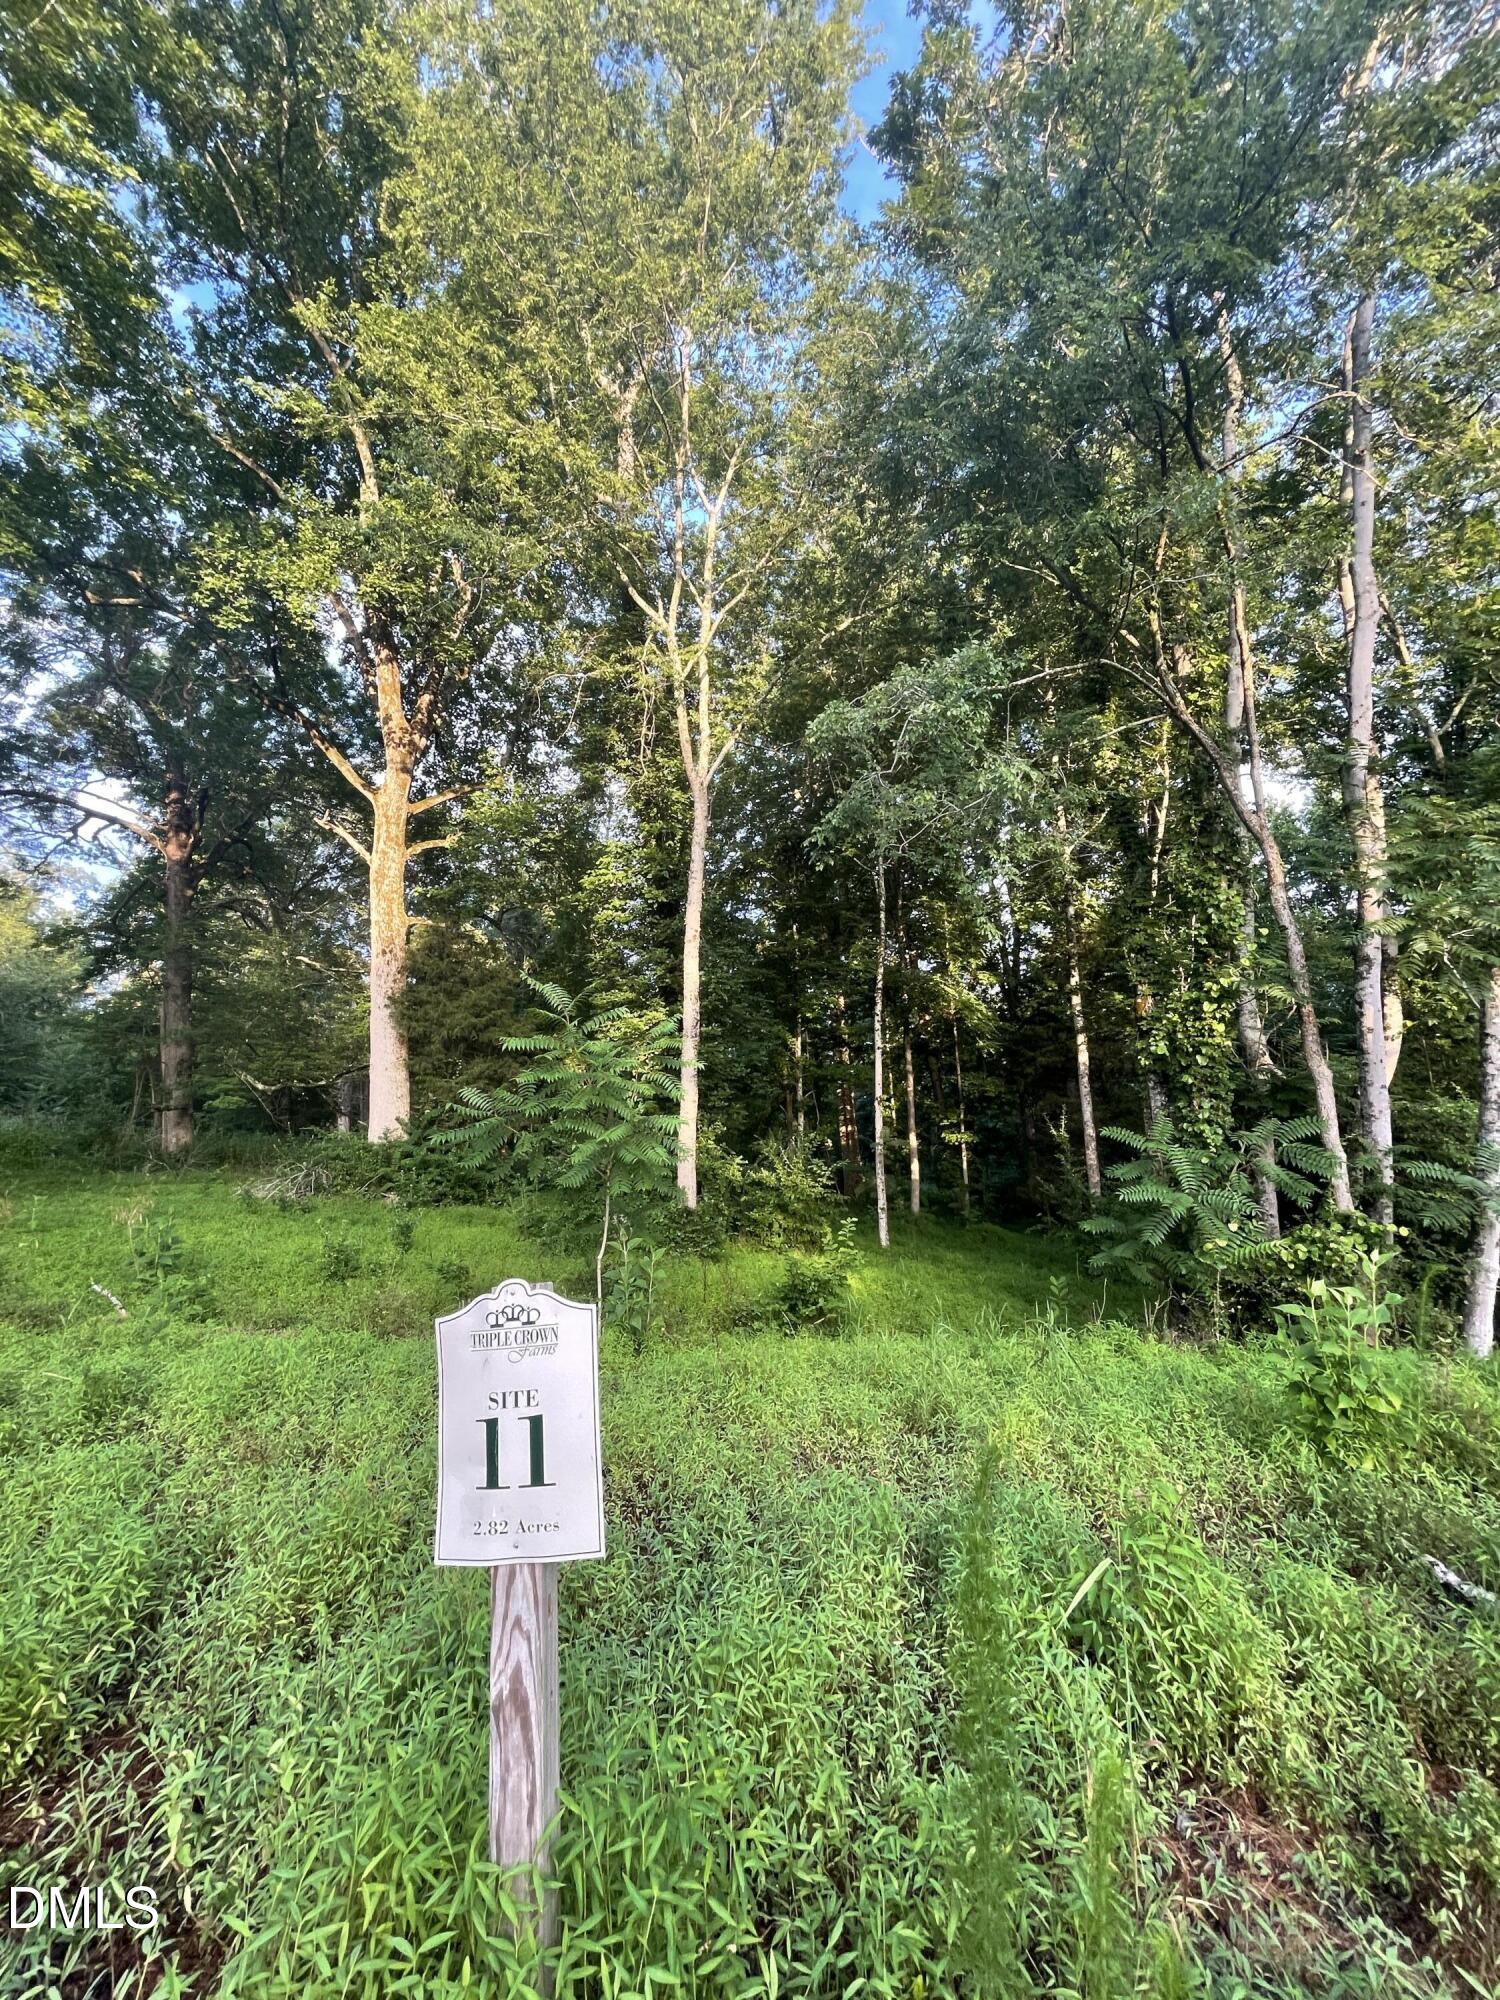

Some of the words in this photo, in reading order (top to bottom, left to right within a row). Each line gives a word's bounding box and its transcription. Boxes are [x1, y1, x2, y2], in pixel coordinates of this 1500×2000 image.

[471, 1331, 512, 1349] TRIPLE
[514, 1326, 559, 1345] CROWN
[508, 1344, 558, 1363] Farms
[488, 1389, 539, 1410] SITE
[476, 1414, 556, 1490] 11
[473, 1520, 509, 1536] 2.82
[515, 1519, 560, 1534] Acres
